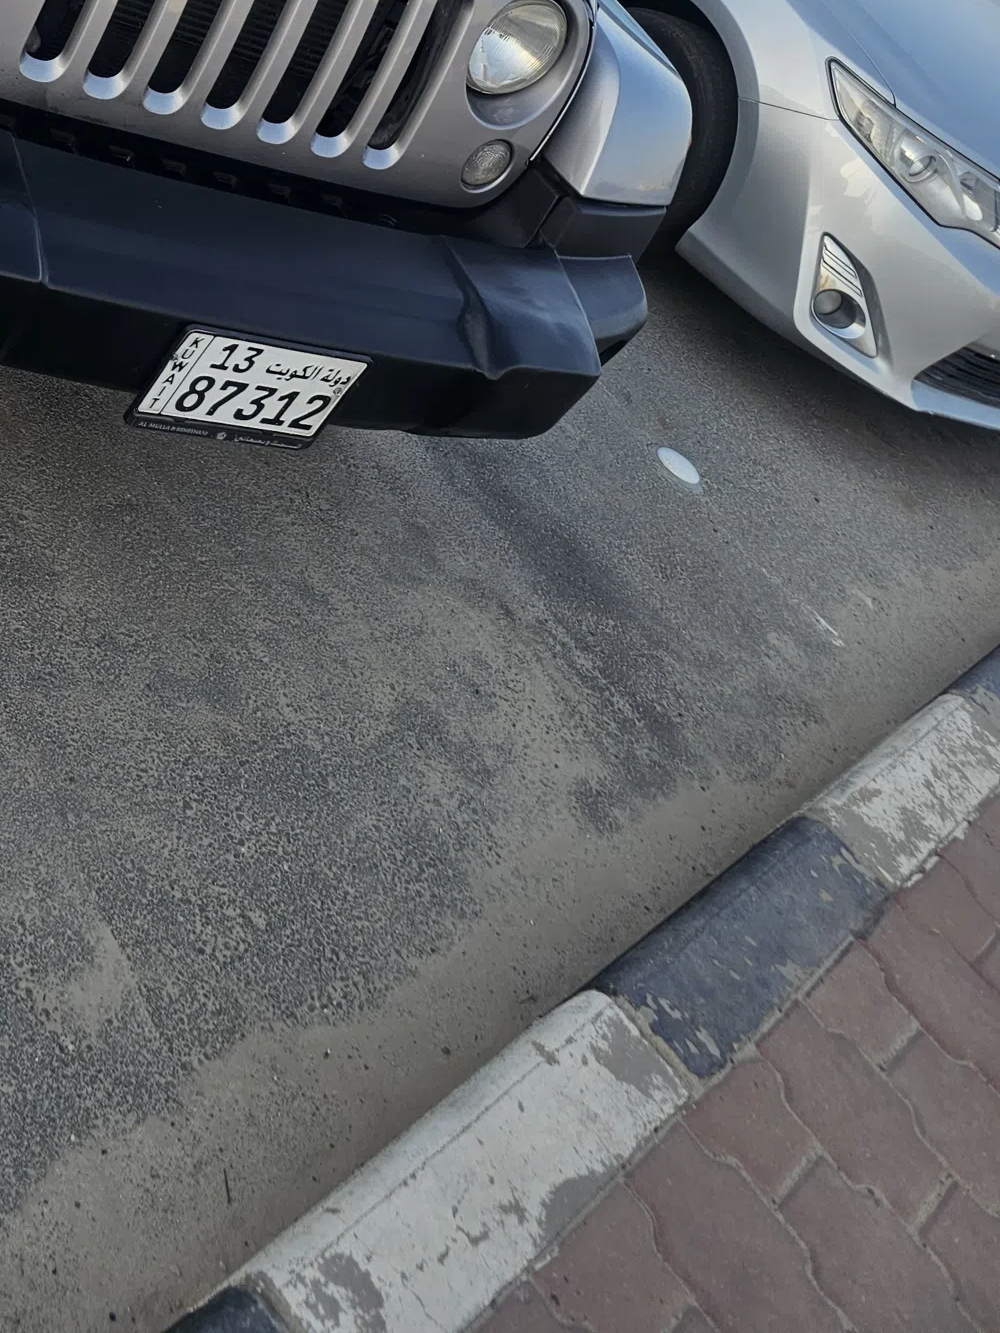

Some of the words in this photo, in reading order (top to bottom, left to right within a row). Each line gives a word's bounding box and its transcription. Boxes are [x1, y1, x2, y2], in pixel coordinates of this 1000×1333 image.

[148, 336, 205, 409] KUWAIT
[209, 343, 265, 374] 13
[265, 362, 322, 382] الكويت
[320, 368, 351, 388] دولة
[174, 375, 332, 431] 87312
